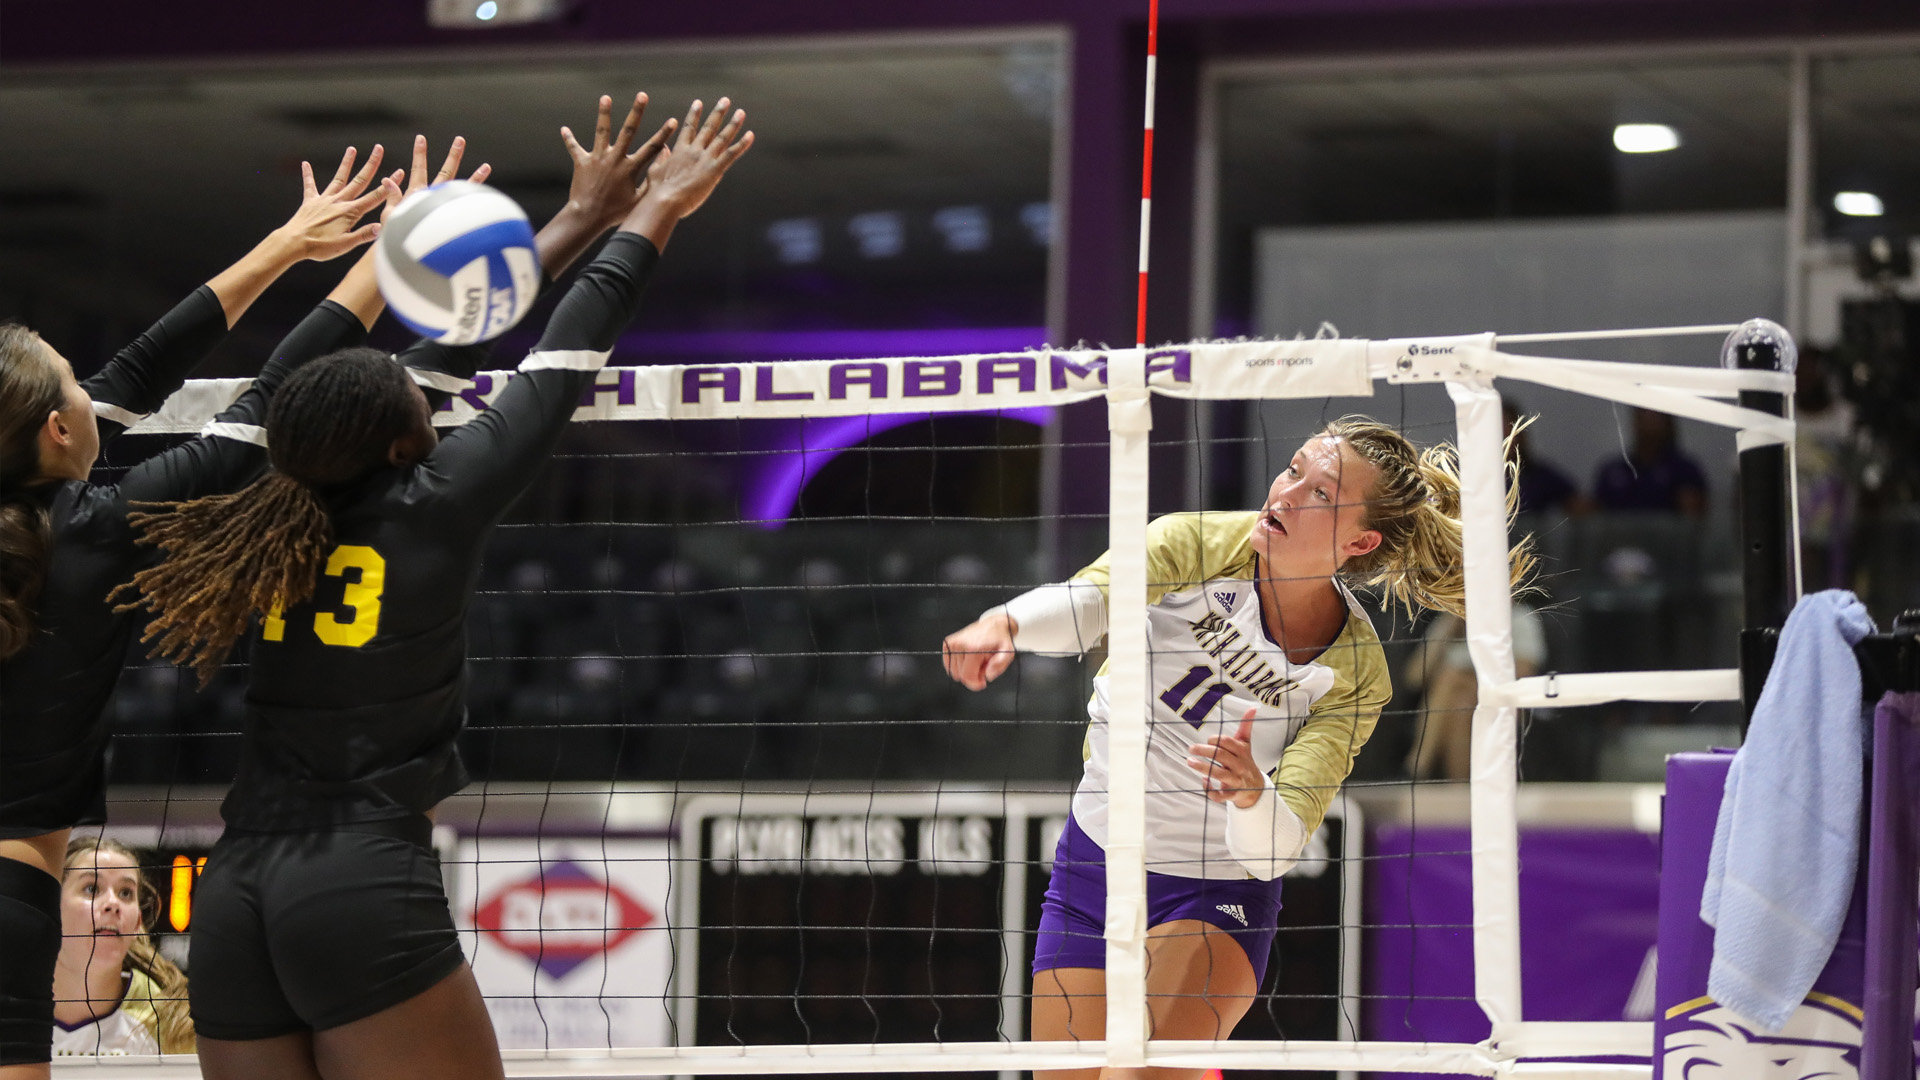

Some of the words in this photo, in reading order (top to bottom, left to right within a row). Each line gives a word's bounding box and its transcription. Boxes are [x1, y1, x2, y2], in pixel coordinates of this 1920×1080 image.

[1245, 358, 1275, 367] sports
[682, 350, 1191, 404] ALABAMA
[1213, 591, 1233, 613] adidas
[1159, 664, 1235, 731] 11
[1215, 904, 1248, 927] adidas
